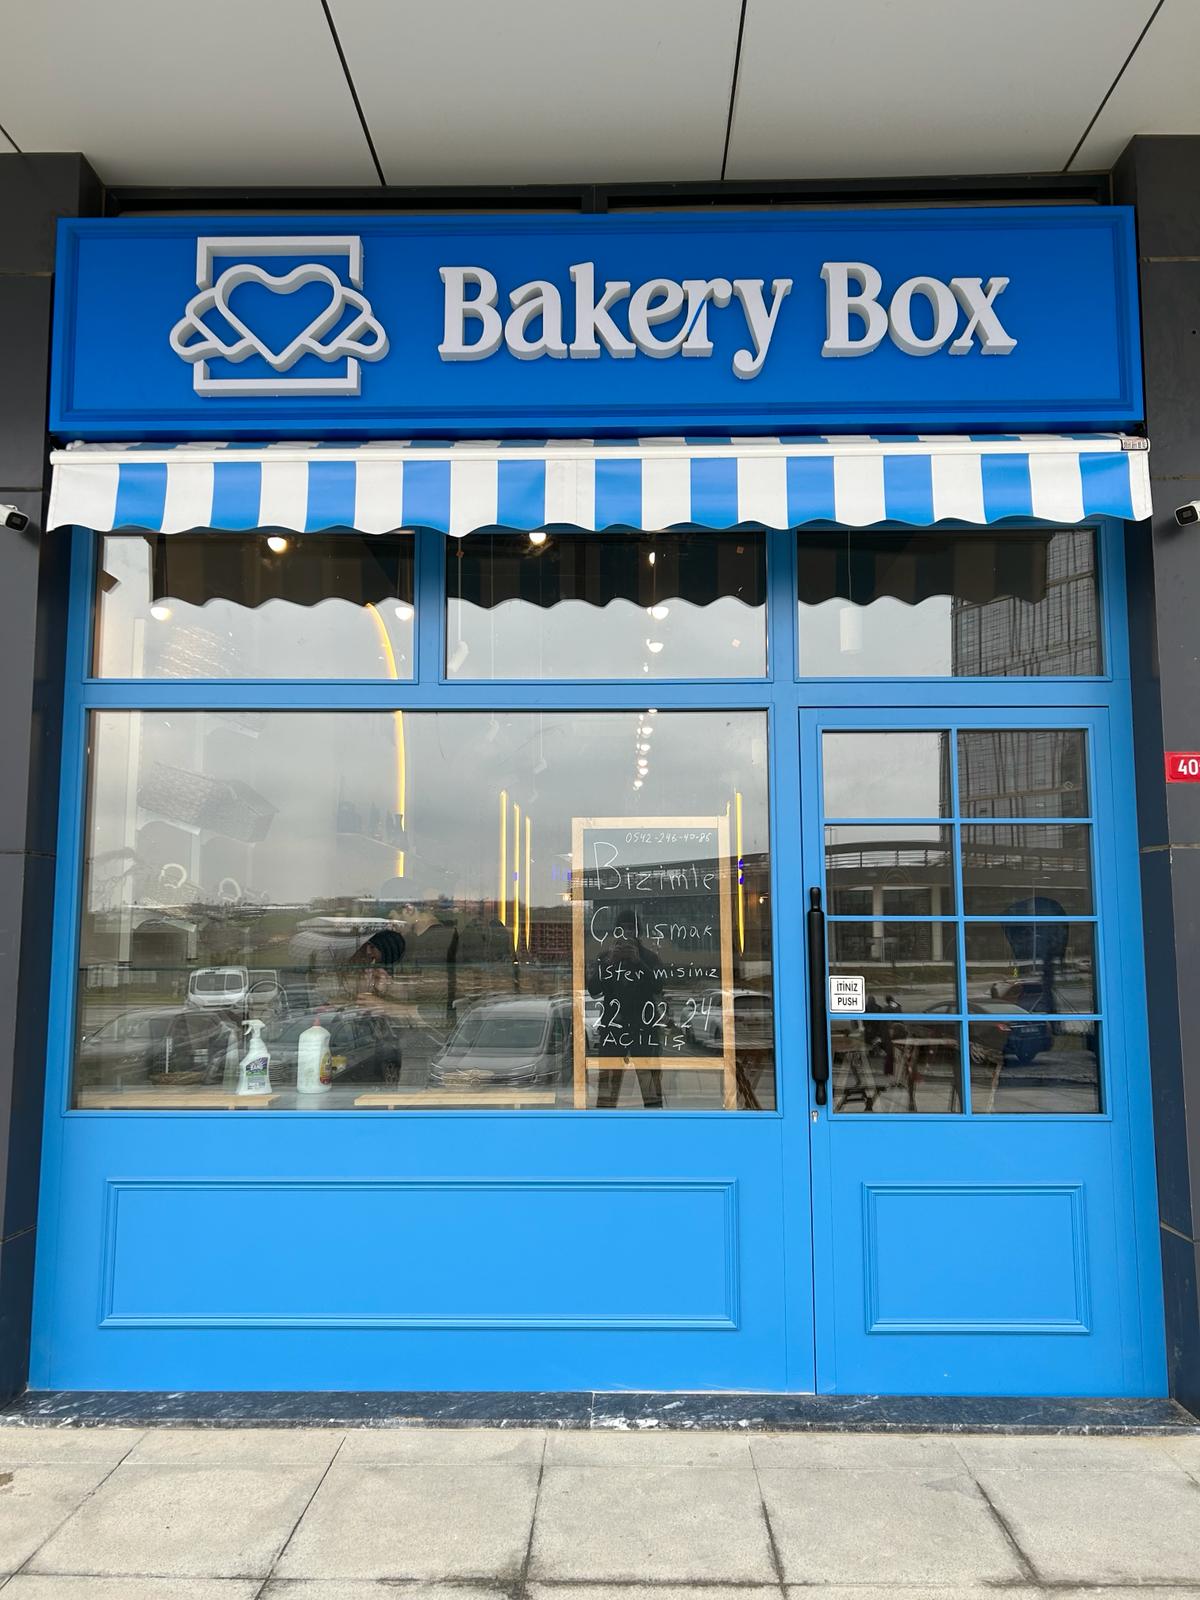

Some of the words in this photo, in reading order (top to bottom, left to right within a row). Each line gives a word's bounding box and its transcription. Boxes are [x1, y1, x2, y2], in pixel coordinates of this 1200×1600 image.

[439, 262, 793, 380] Bakery
[821, 262, 1018, 358] Box
[1177, 759, 1200, 776] 40
[593, 841, 715, 891] Bizimle
[590, 906, 713, 946] Çalışmak
[597, 958, 645, 982] ister
[837, 997, 858, 1006] PUSH
